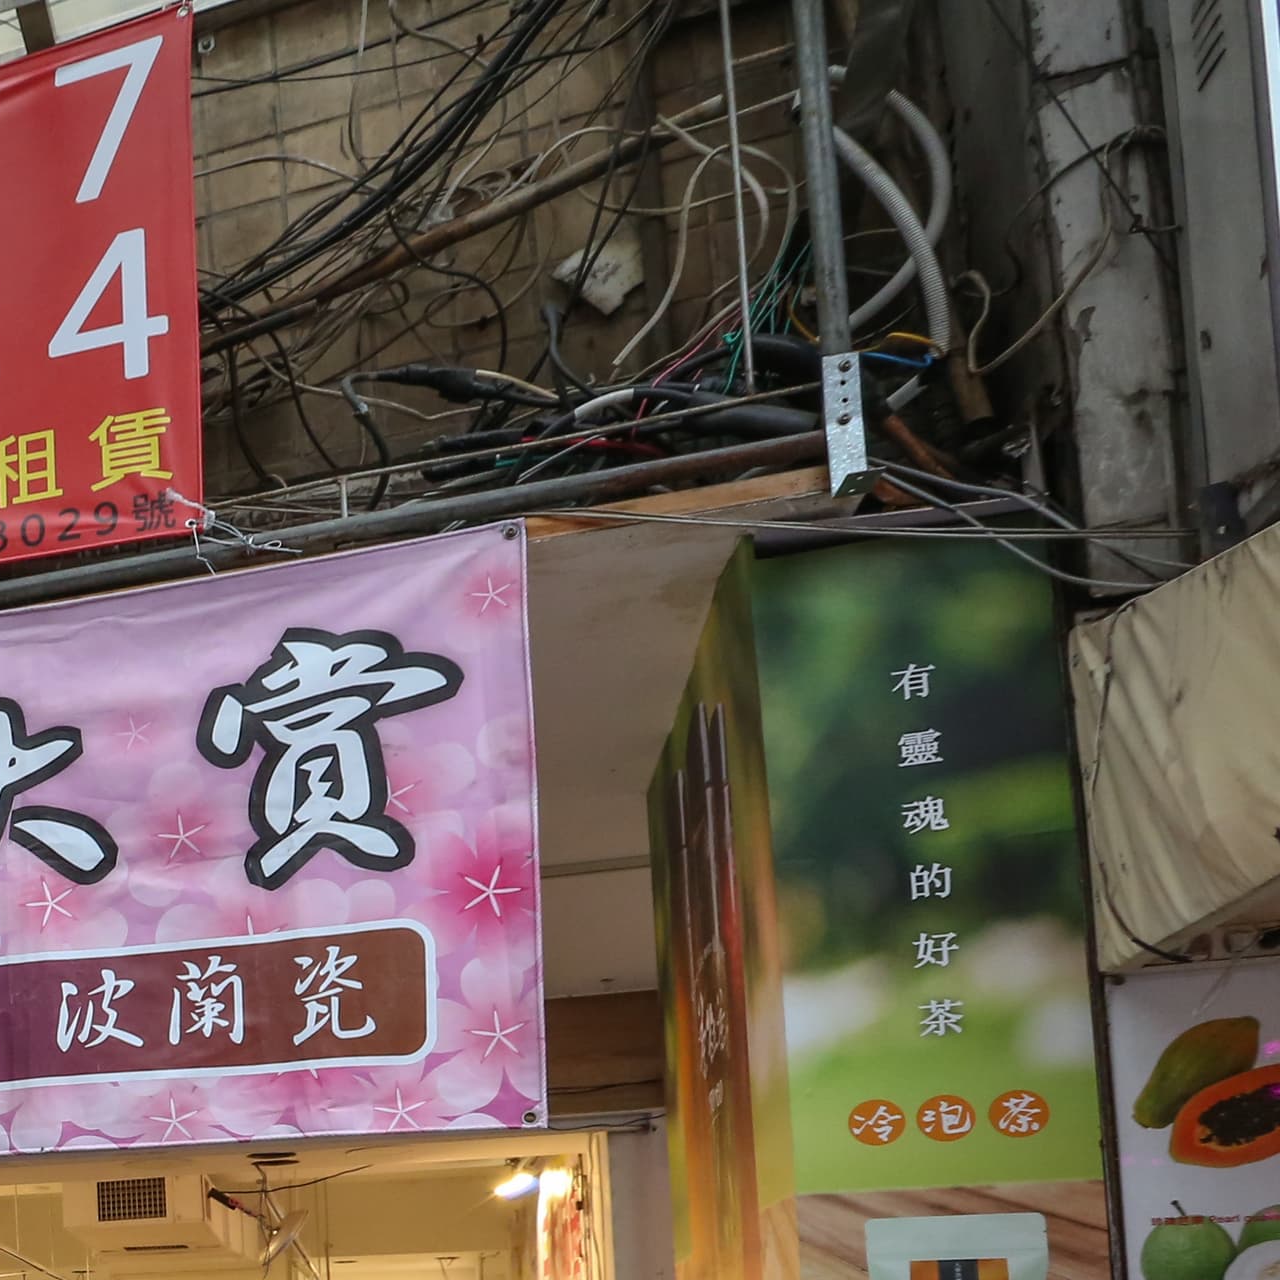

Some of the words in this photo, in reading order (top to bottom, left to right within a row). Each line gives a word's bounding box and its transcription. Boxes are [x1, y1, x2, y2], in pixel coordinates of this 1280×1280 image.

[890, 663, 964, 1038] 有靈魂的好茶
[851, 1092, 1042, 1144] 冷泡茶
